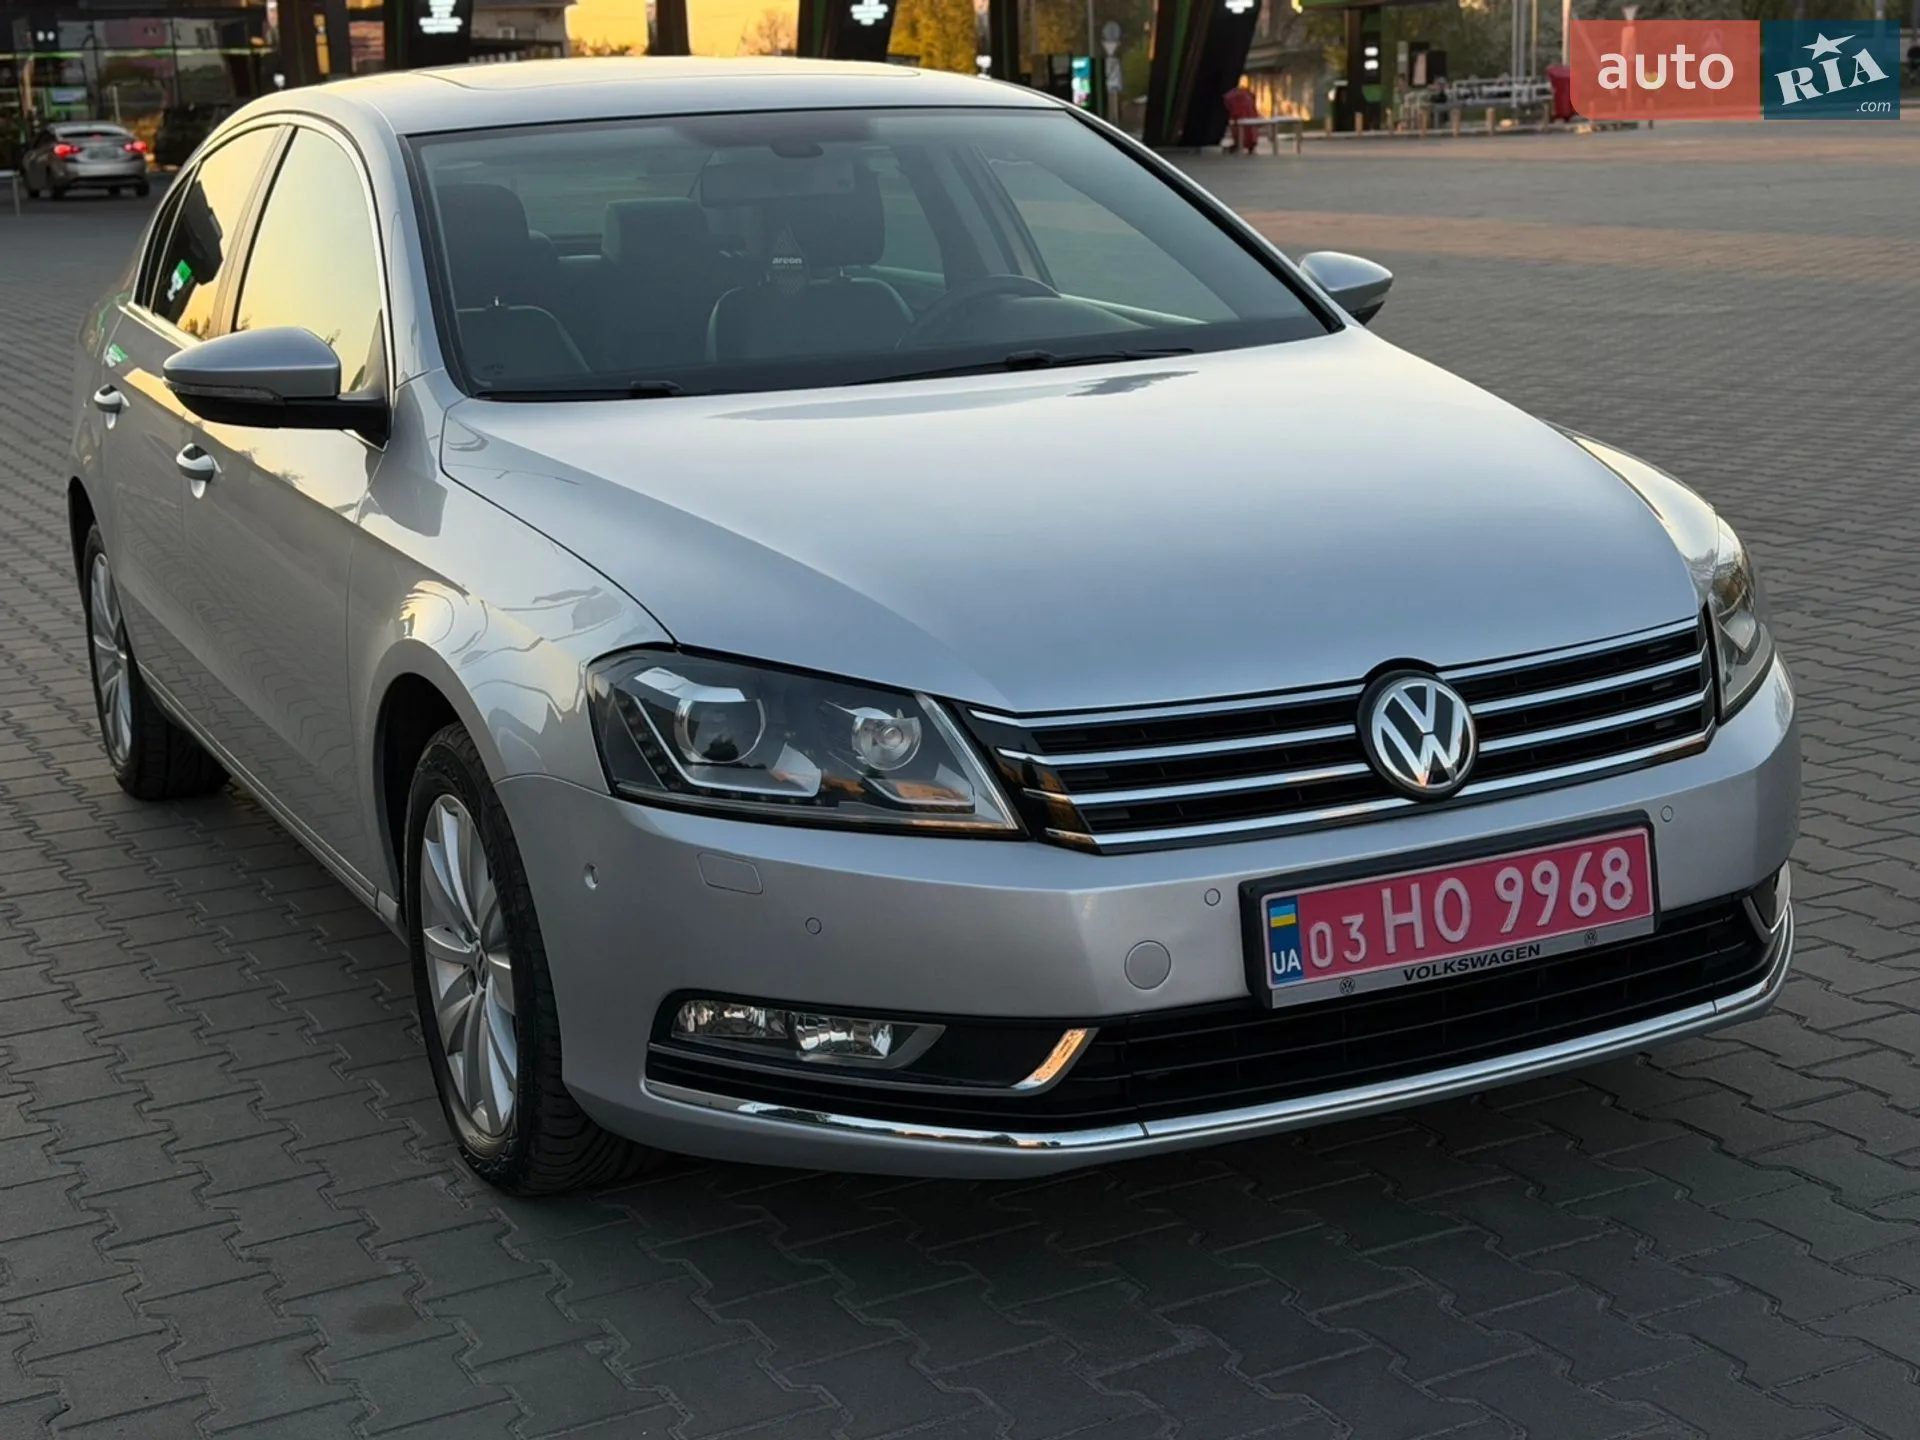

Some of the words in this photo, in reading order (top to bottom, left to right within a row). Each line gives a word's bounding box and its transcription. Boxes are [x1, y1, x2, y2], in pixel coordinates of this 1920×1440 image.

[1308, 912, 1368, 969] 03
[1381, 876, 1472, 955] HO
[1494, 846, 1635, 934] 9968
[1272, 948, 1302, 975] UA
[1403, 943, 1541, 982] VOLKSWAGEN
